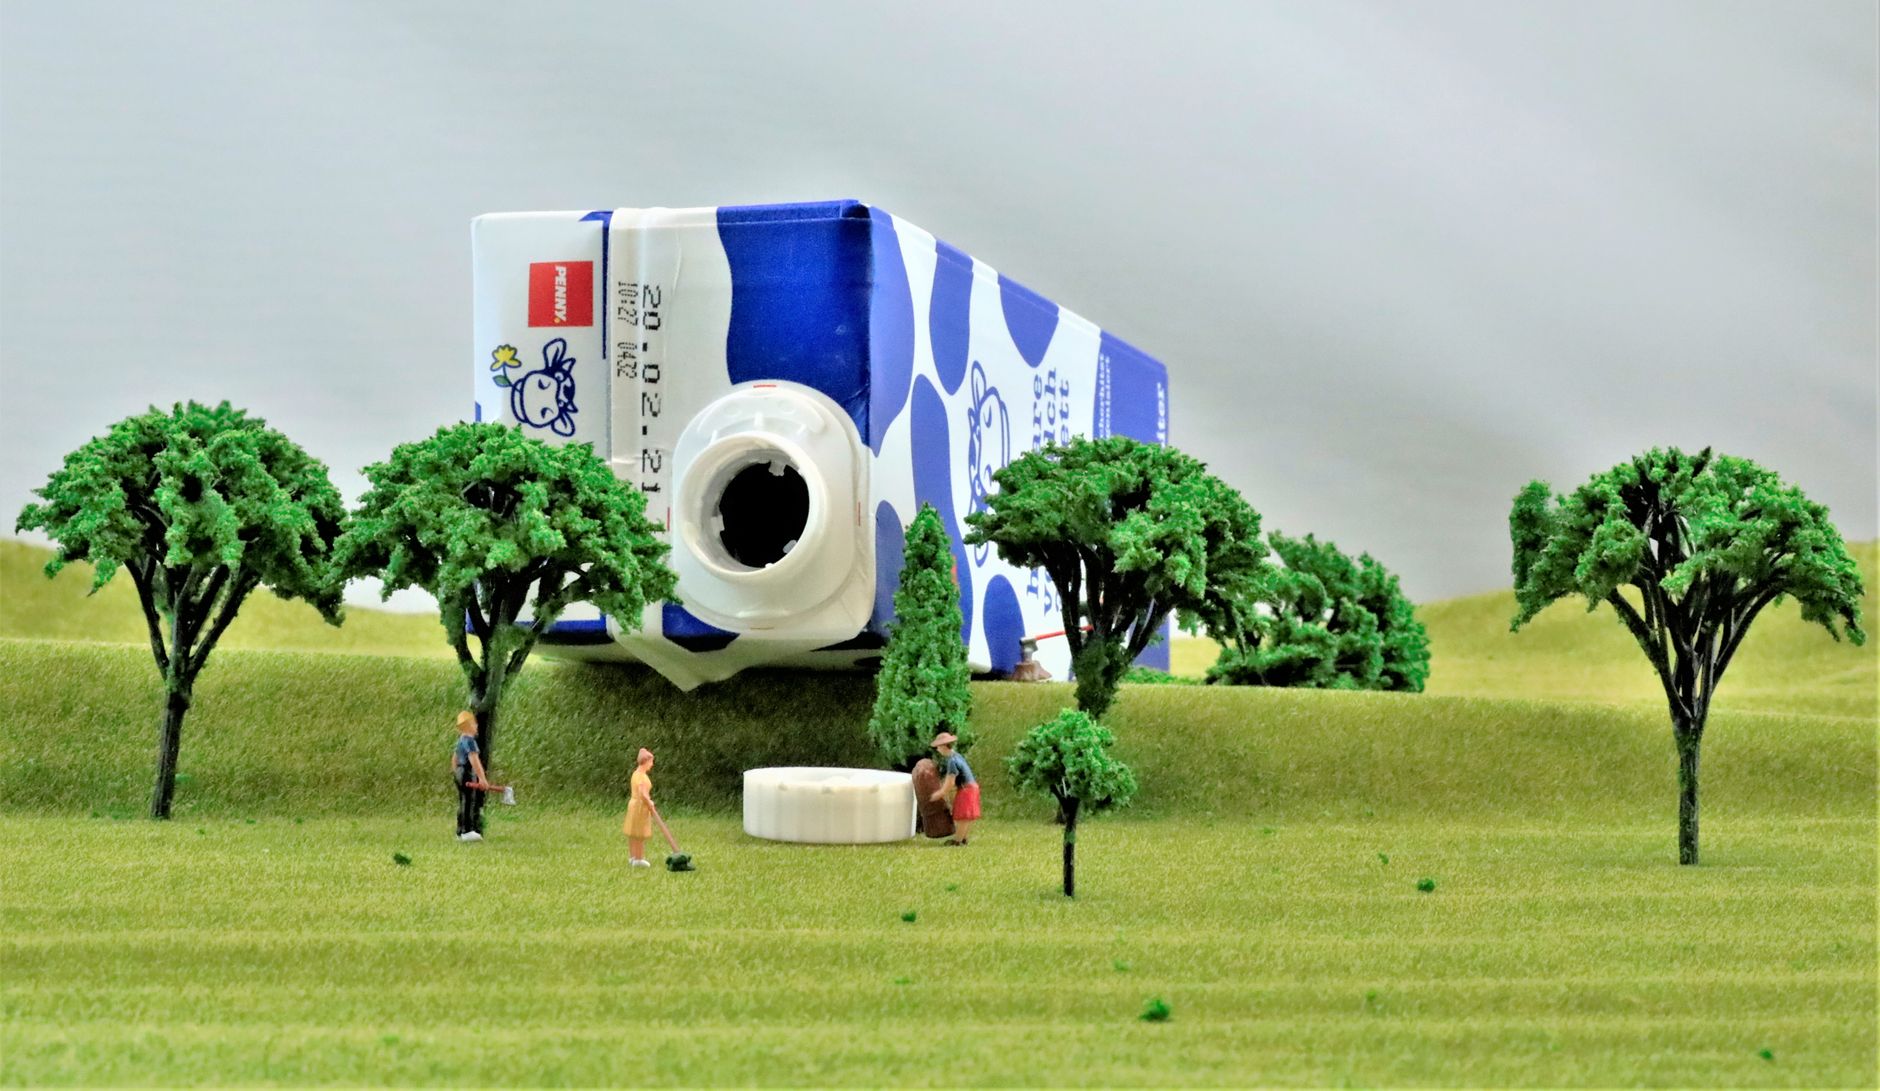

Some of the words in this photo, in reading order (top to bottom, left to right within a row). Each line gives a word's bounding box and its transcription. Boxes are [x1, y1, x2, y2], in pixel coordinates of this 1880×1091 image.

[618, 281, 638, 326] 10:27
[617, 341, 638, 379] 0432
[641, 284, 661, 492] 20.02.21
[1060, 379, 1069, 447] ett
[1157, 382, 1165, 448] iter
